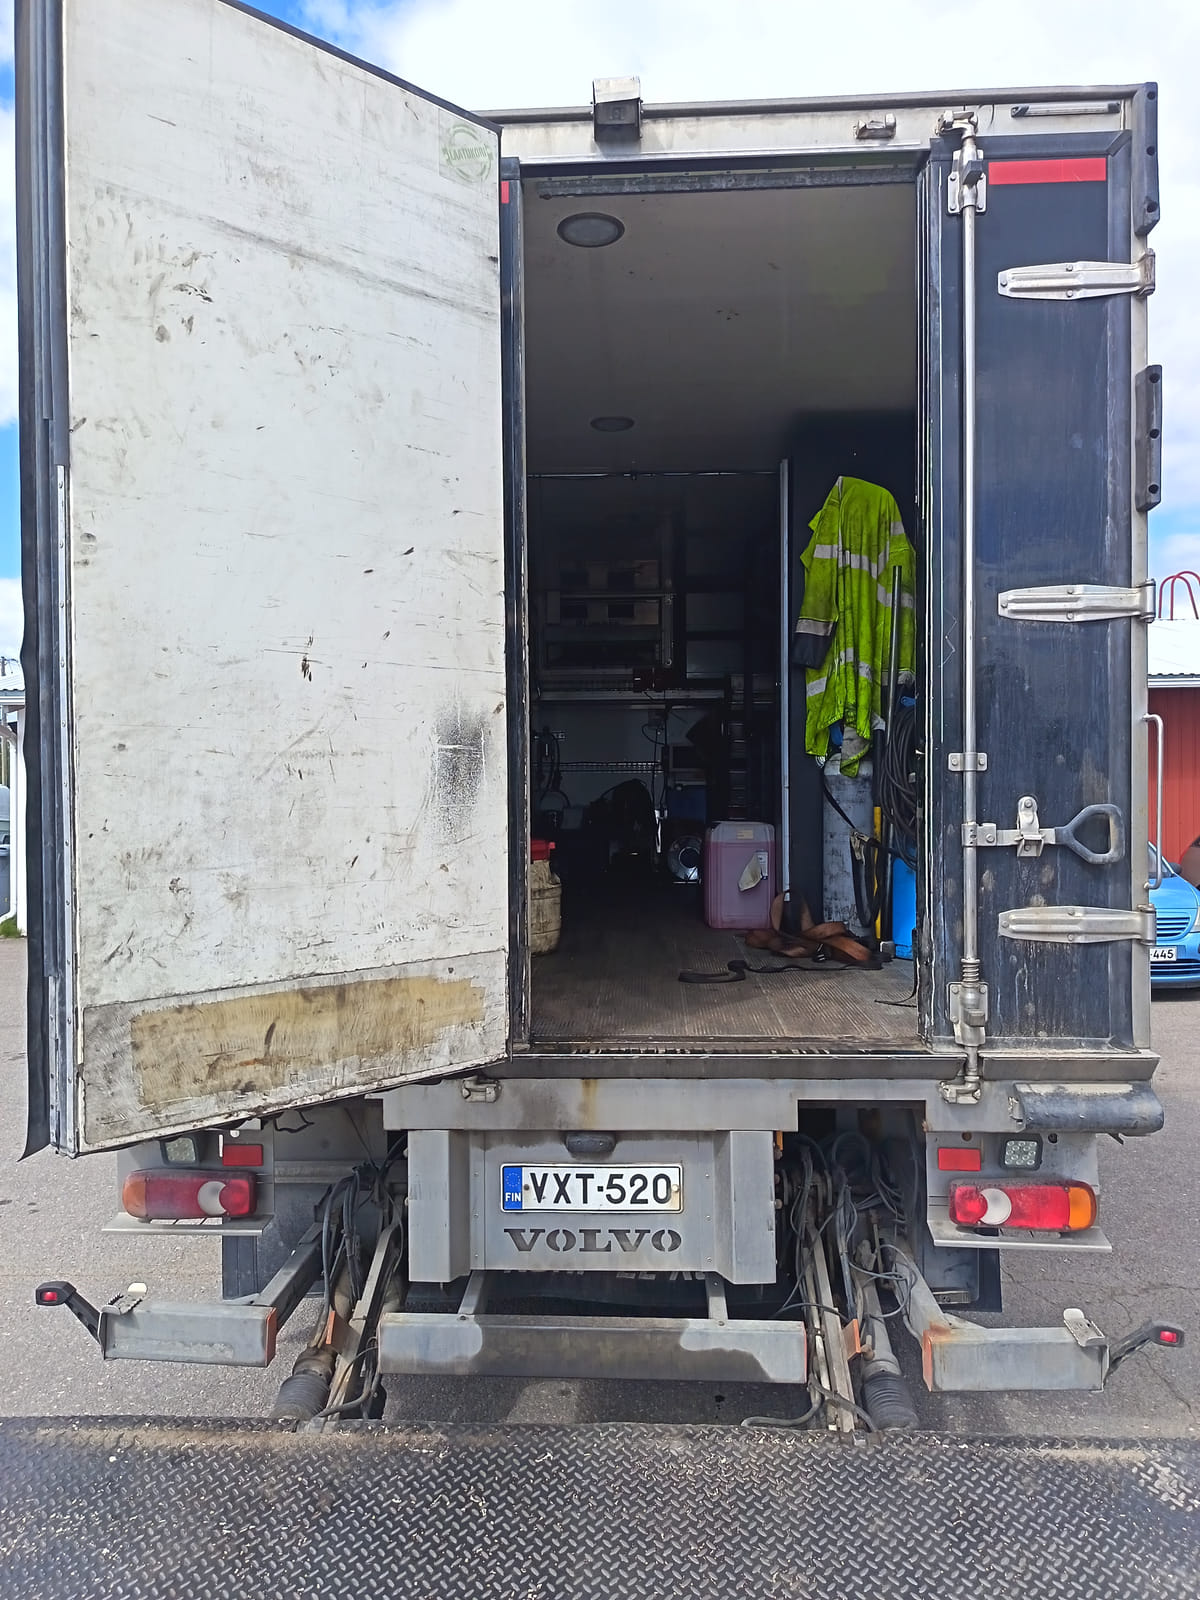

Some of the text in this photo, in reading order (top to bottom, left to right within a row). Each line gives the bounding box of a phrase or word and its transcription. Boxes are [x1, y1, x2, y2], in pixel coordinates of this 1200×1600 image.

[505, 1173, 672, 1204] FIN VXT-520
[503, 1228, 682, 1252] VOLVO
